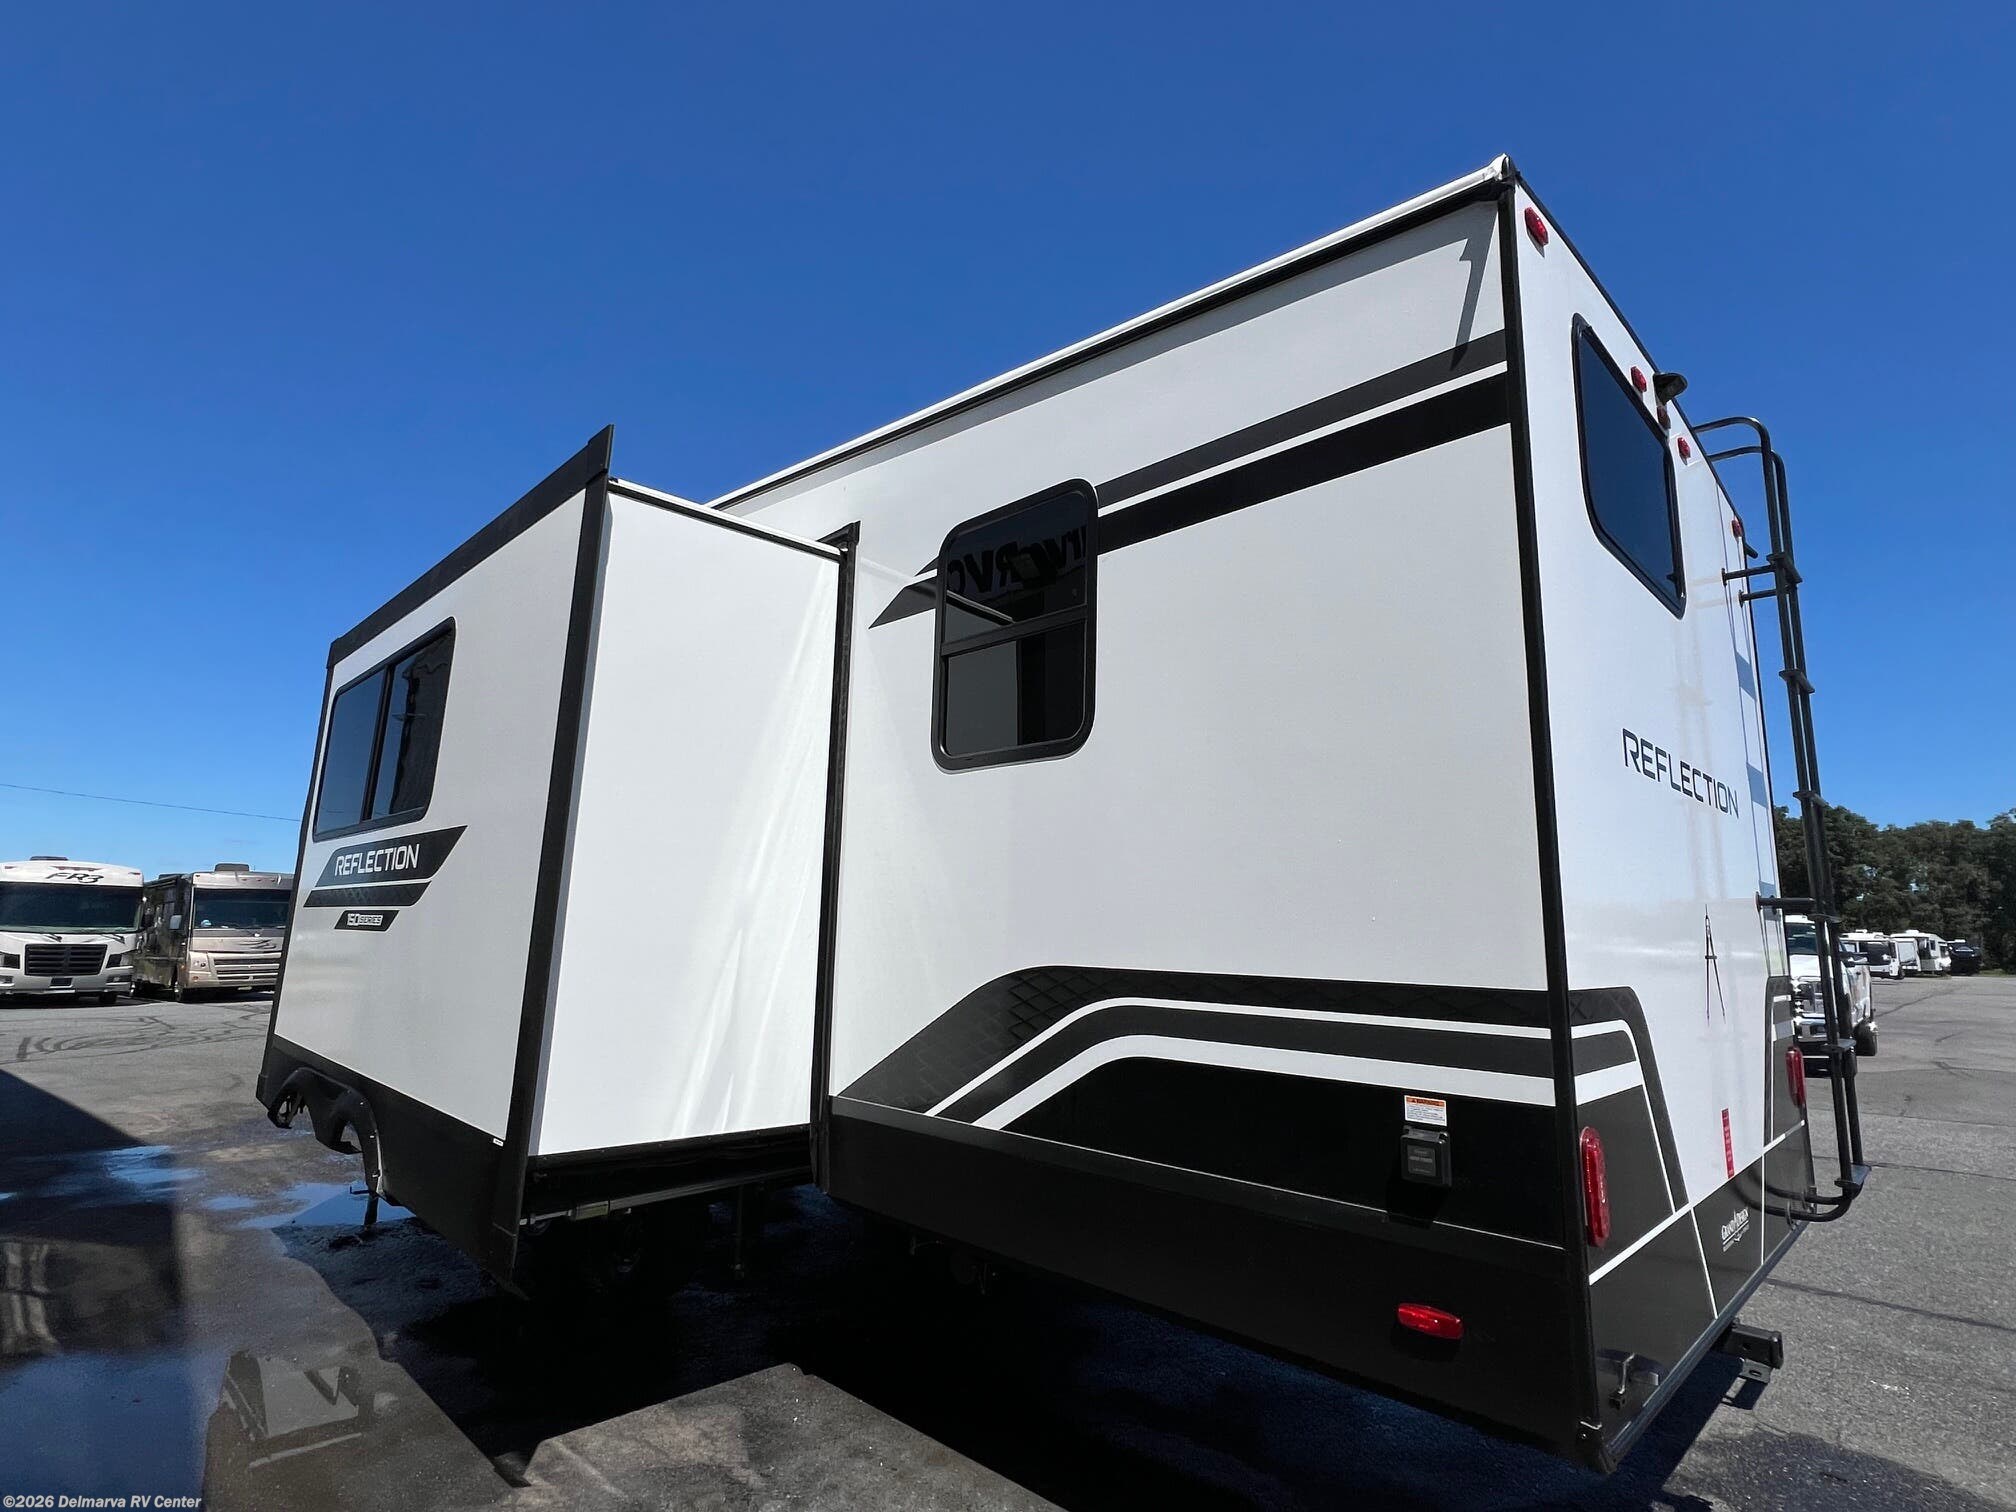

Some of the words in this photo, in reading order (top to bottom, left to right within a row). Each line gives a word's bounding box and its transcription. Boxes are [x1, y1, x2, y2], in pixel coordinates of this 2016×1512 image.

[1622, 728, 1739, 820] REFLECTION
[335, 843, 420, 876] REFLECTION
[45, 872, 105, 883] FR3
